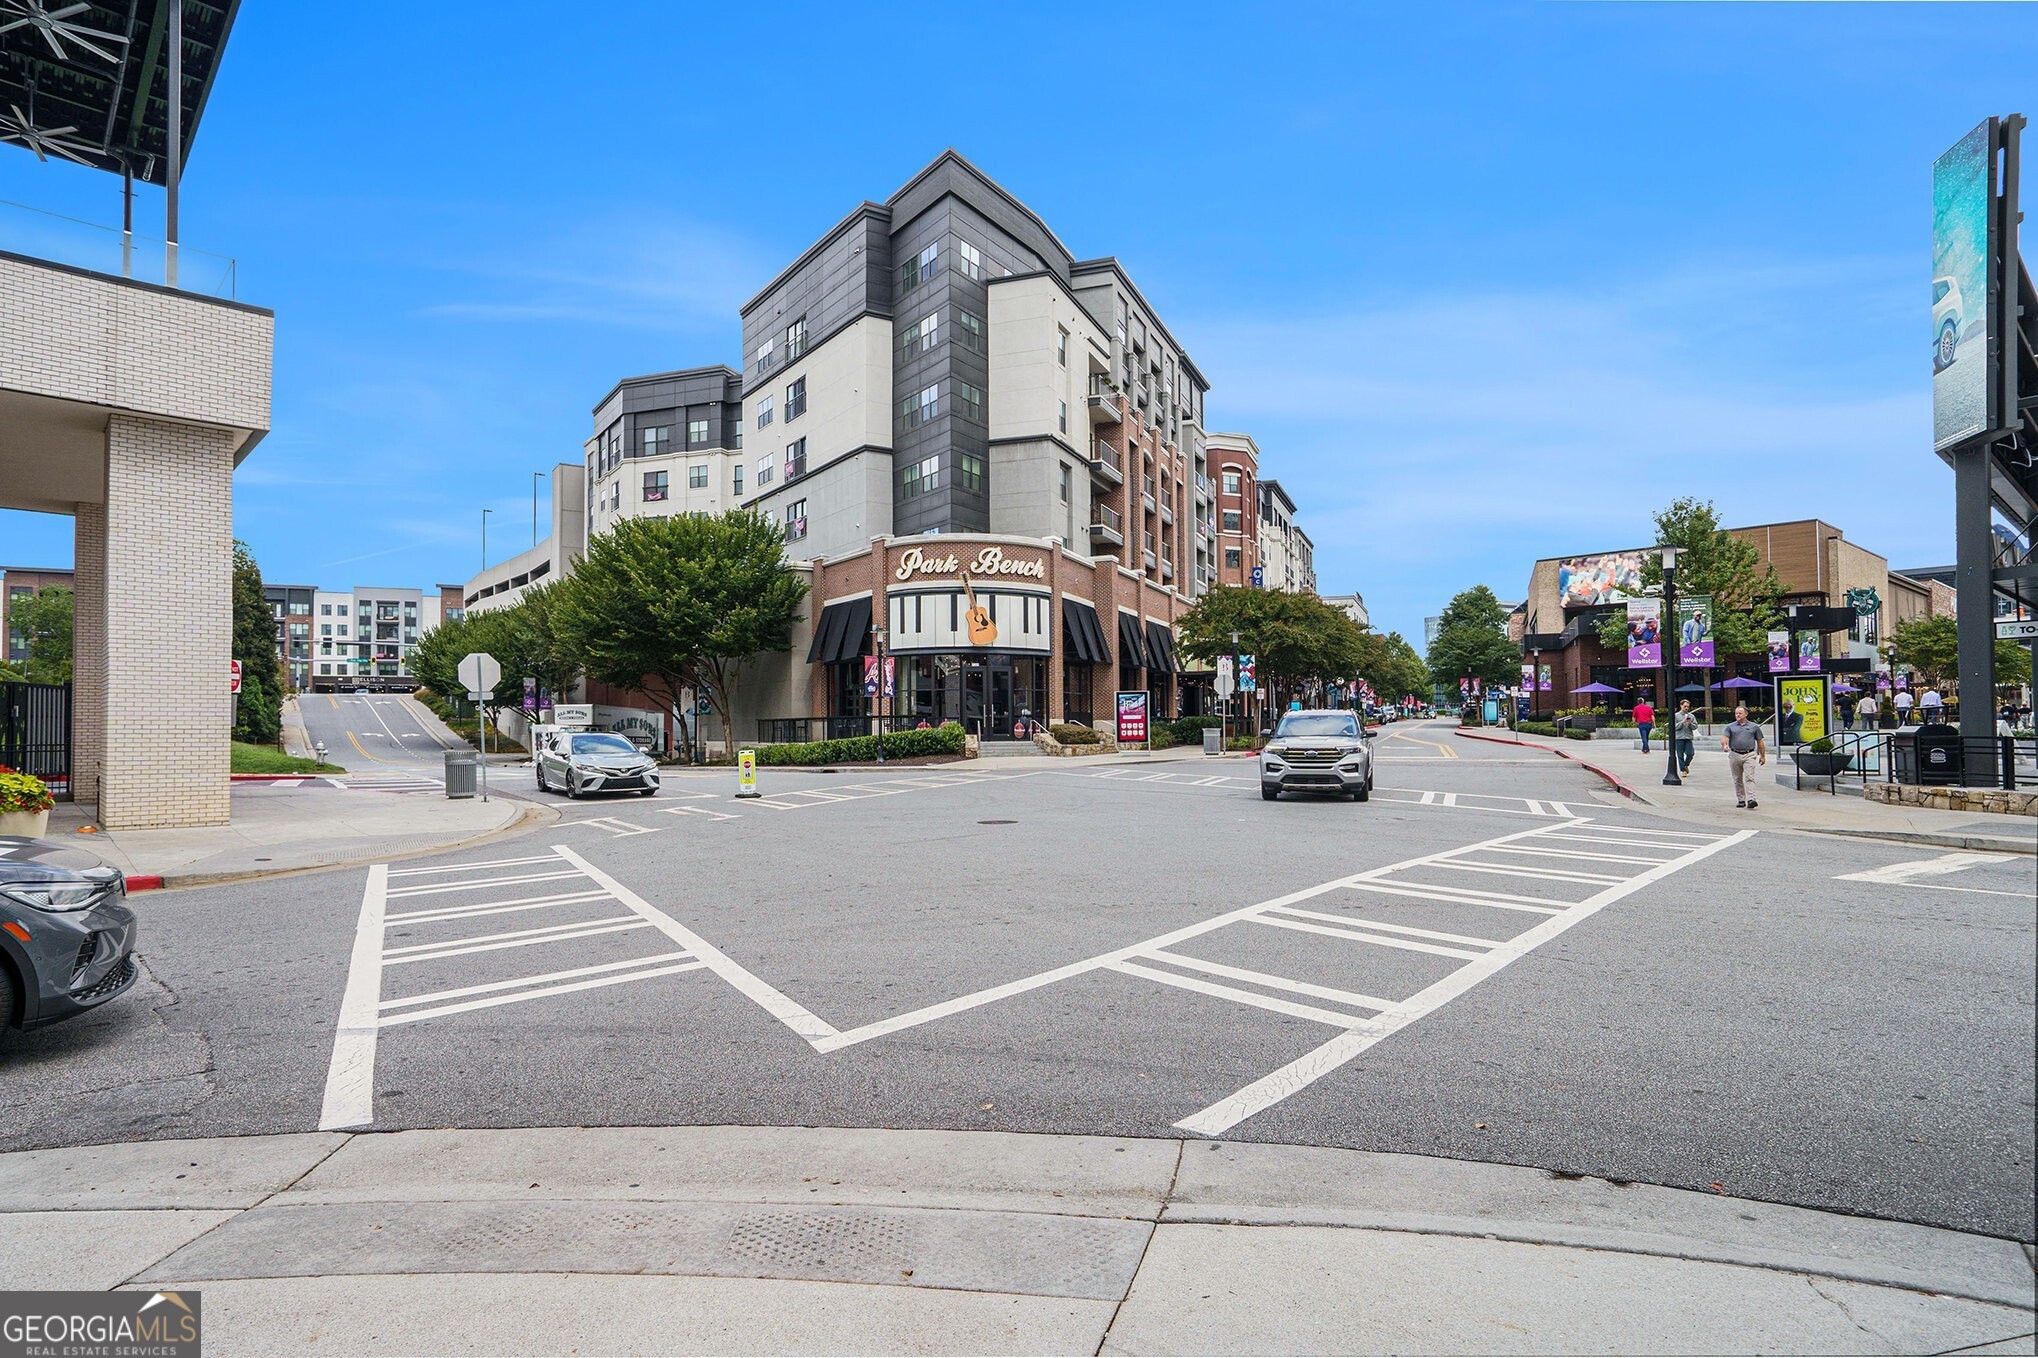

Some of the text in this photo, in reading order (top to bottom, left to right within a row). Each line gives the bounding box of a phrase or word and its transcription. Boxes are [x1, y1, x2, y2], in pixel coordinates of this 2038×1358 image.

[895, 547, 1045, 580] Park Bench
[1783, 688, 1818, 696] JOHN
[626, 717, 639, 729] MY
